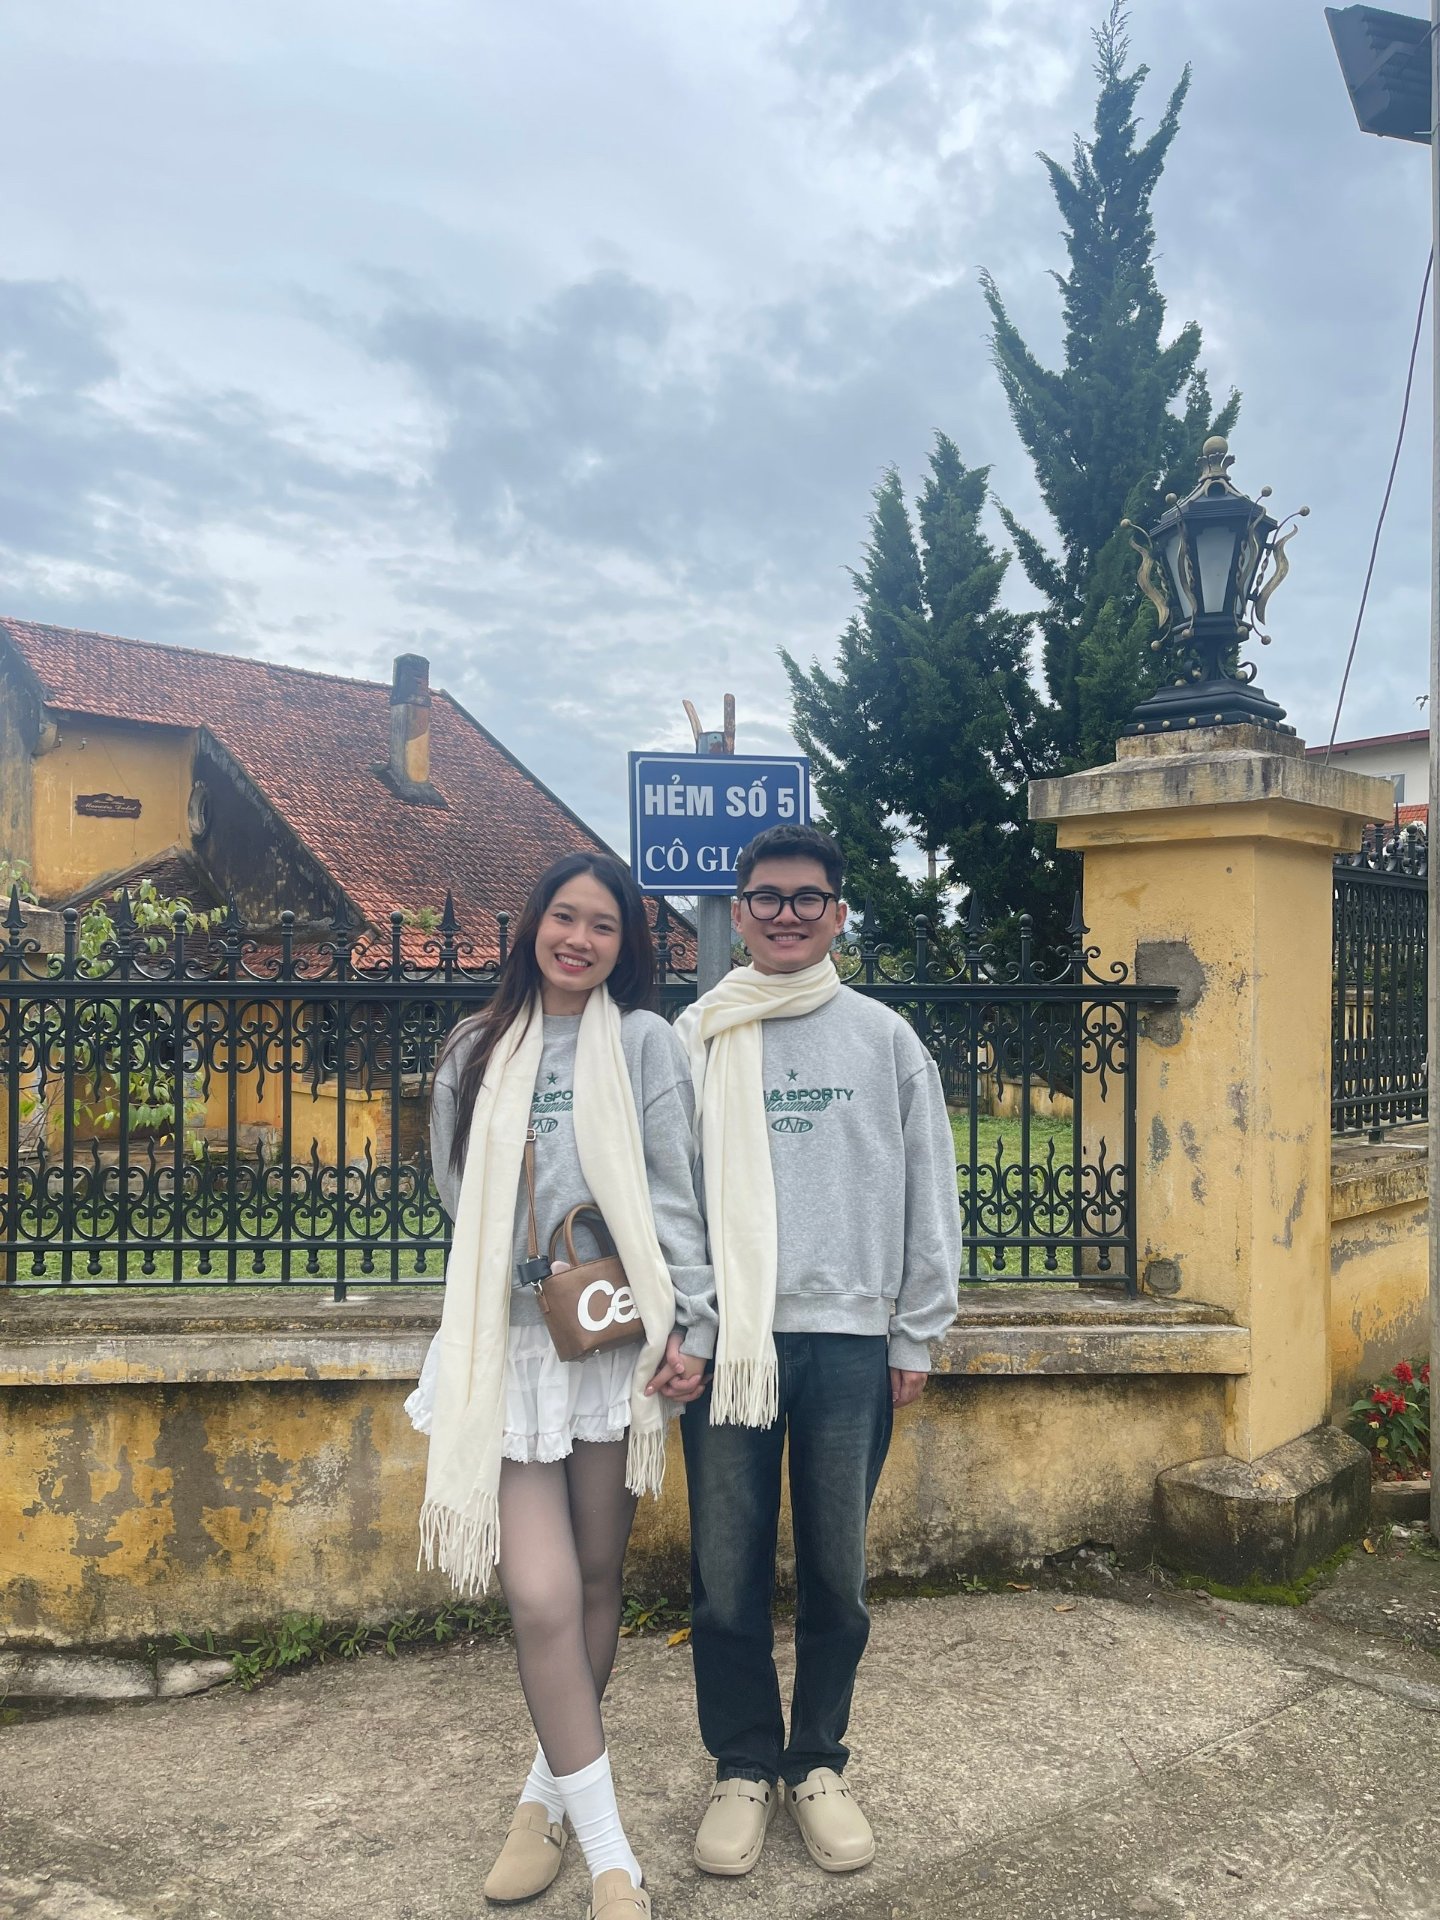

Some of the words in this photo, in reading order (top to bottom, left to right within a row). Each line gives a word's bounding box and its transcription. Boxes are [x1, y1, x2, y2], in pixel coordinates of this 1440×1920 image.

[644, 774, 714, 817] HẺM
[725, 776, 768, 818] SỐ
[777, 787, 795, 818] 5
[645, 837, 689, 872] CÔ
[786, 1087, 854, 1101] SPORTY
[577, 1279, 641, 1332] Ce
